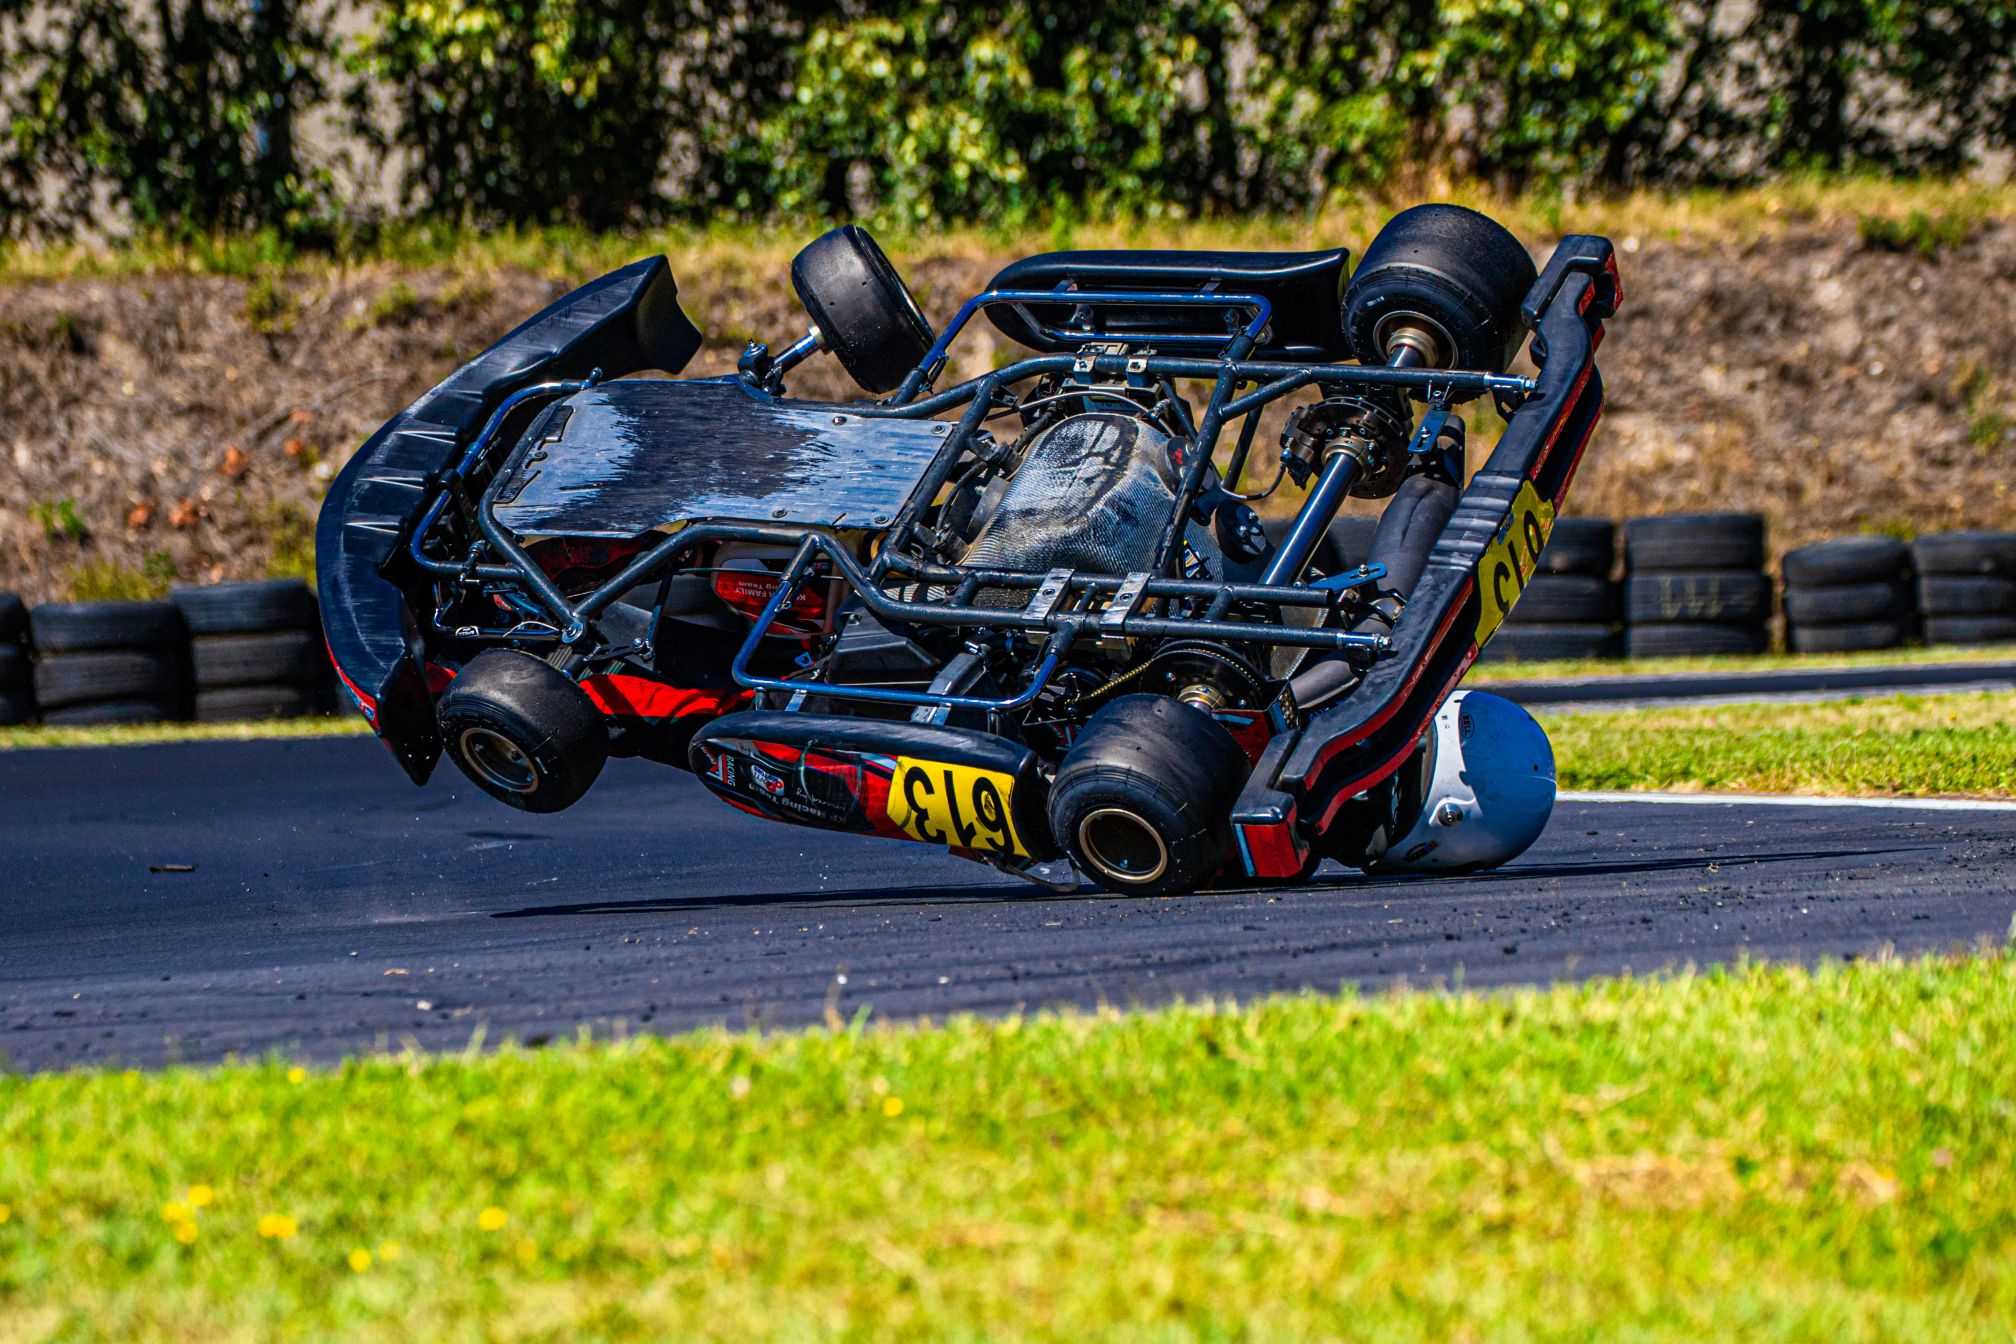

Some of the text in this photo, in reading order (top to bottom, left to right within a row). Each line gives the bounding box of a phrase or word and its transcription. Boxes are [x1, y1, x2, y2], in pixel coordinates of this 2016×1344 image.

[735, 587, 767, 598] FAMILY
[738, 581, 764, 590] Team
[727, 754, 737, 787] RACING
[904, 766, 1014, 854] 613
